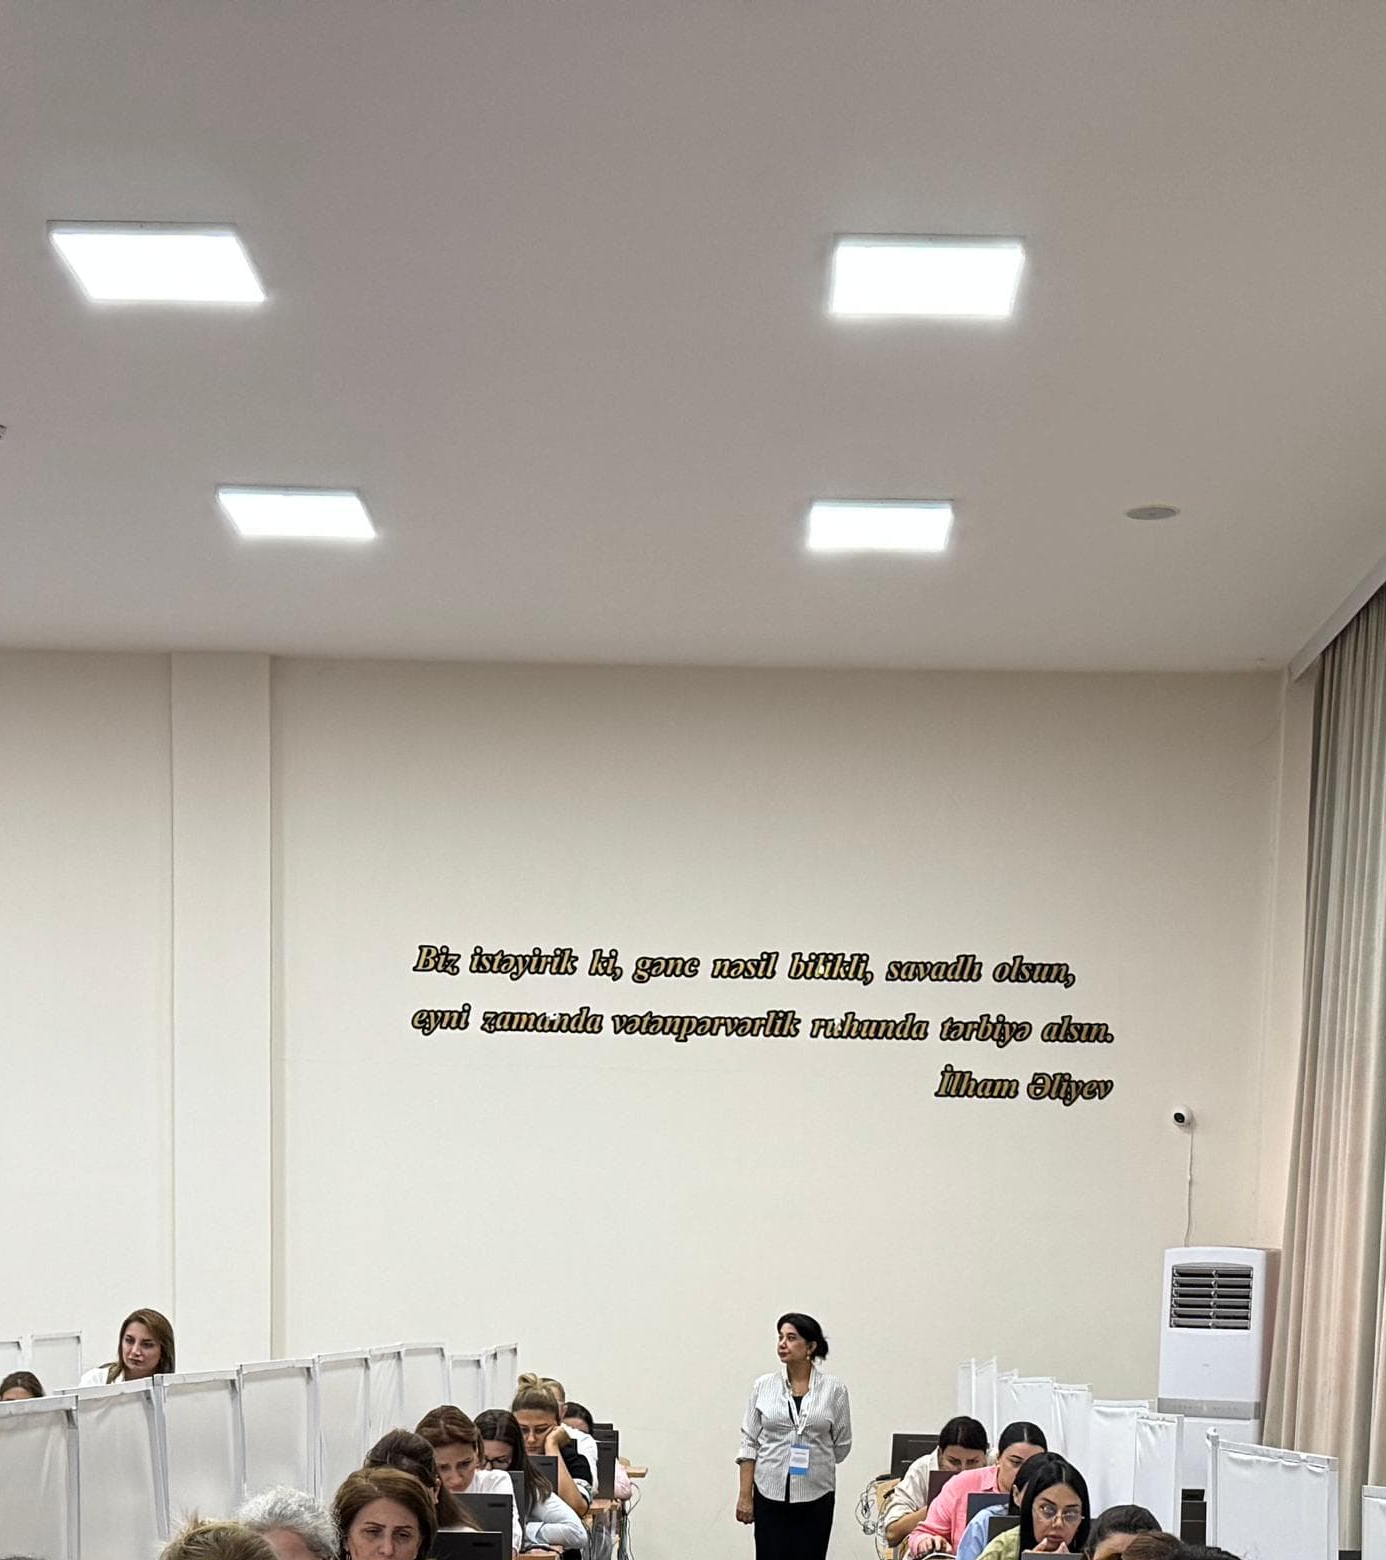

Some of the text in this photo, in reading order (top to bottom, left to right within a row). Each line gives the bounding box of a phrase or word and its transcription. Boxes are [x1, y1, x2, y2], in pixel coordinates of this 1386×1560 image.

[413, 945, 461, 976] Biz
[469, 946, 578, 981] istəyirik
[588, 949, 623, 981] ki,
[632, 957, 700, 983] gənc
[711, 952, 779, 979] nəsil
[885, 954, 982, 982] savadlı
[993, 955, 1075, 989] olsun,
[412, 1003, 471, 1036] eyni
[481, 1007, 603, 1034] zamanda
[611, 1010, 801, 1042] vətənpərvərlik
[810, 1012, 929, 1040] ruhunda
[940, 1014, 1032, 1048] tərbiyə
[934, 1064, 1114, 1106] İlham Əliyev
